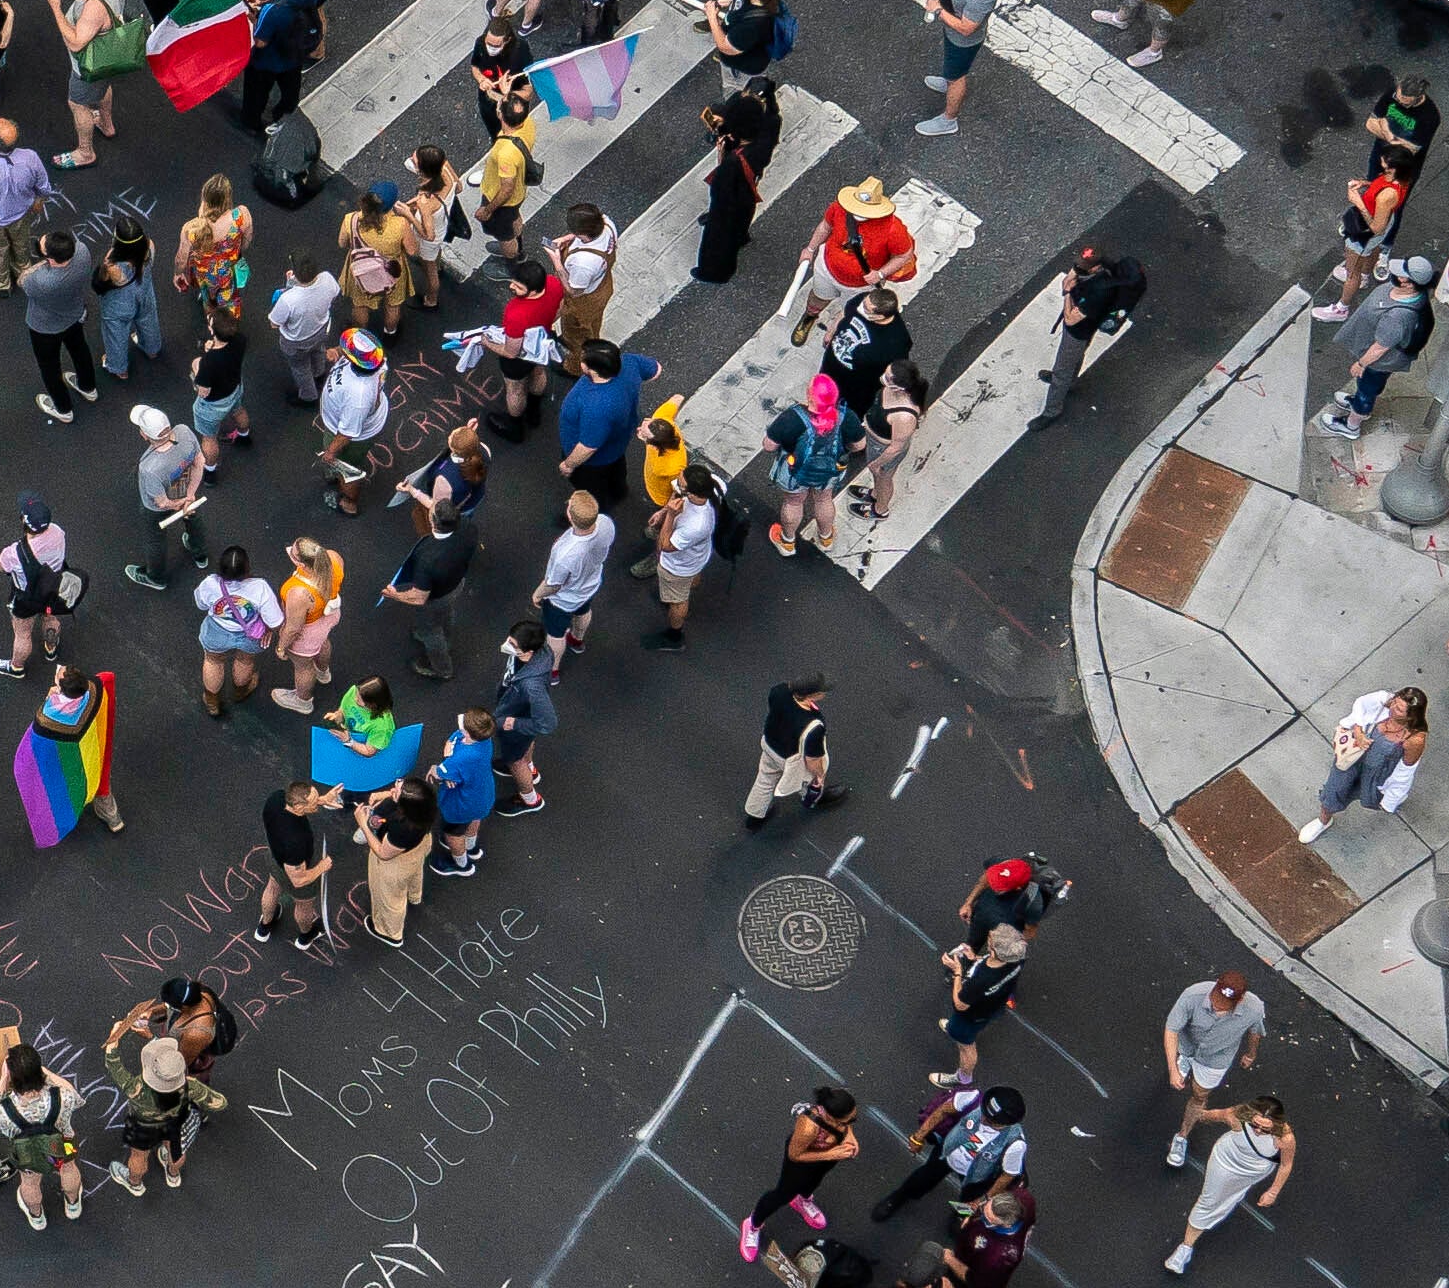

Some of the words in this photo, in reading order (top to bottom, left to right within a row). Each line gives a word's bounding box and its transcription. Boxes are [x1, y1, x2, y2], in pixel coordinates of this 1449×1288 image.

[72, 187, 159, 244] RIME
[395, 368, 503, 452] CRIME
[362, 966, 446, 1022] 4
[416, 907, 540, 1001] Hate
[340, 1131, 467, 1223] Out
[478, 970, 609, 1066] Philly
